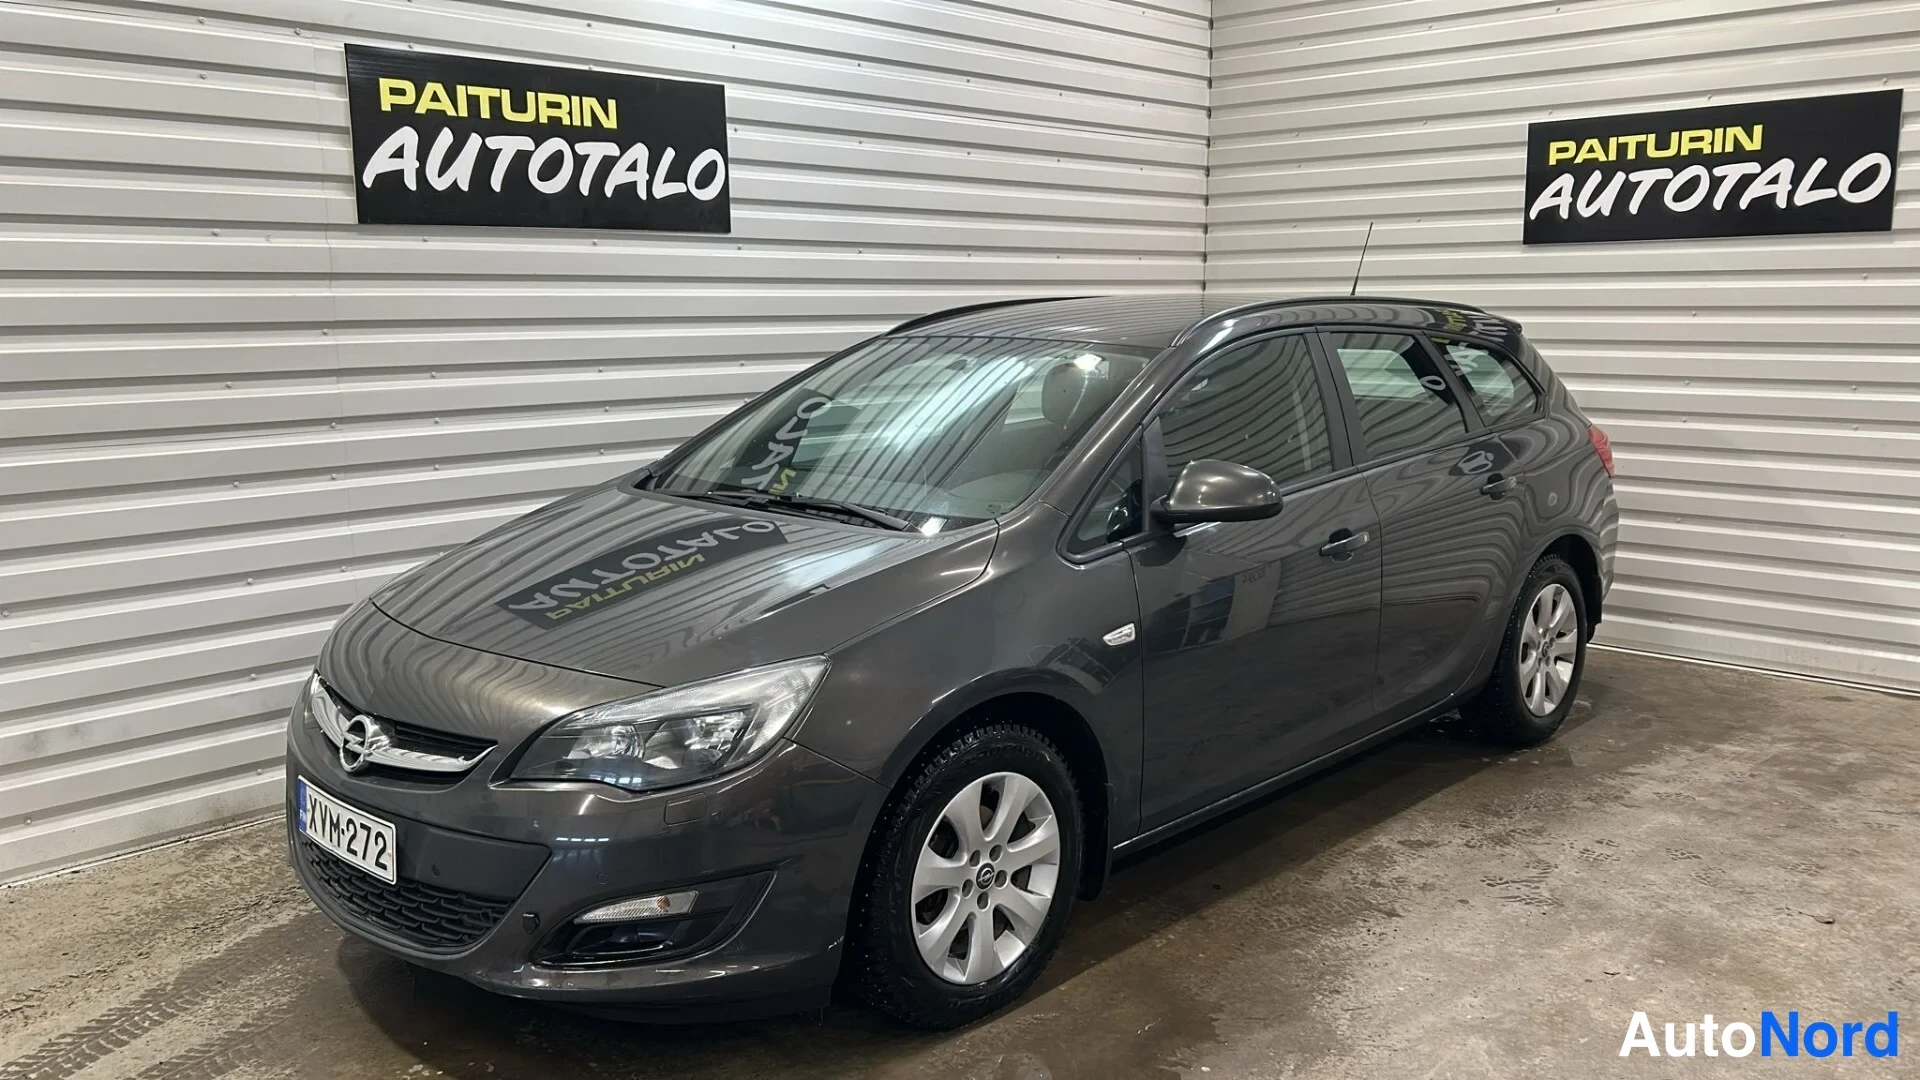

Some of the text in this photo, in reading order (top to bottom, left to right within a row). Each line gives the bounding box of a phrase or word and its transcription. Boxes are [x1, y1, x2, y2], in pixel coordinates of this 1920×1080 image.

[378, 77, 618, 130] PAITURIN
[362, 125, 726, 201] AUTOTALO
[1548, 124, 1764, 166] PAITURIN
[1529, 152, 1893, 221] AUTOTALO
[308, 793, 388, 872] XVM-272
